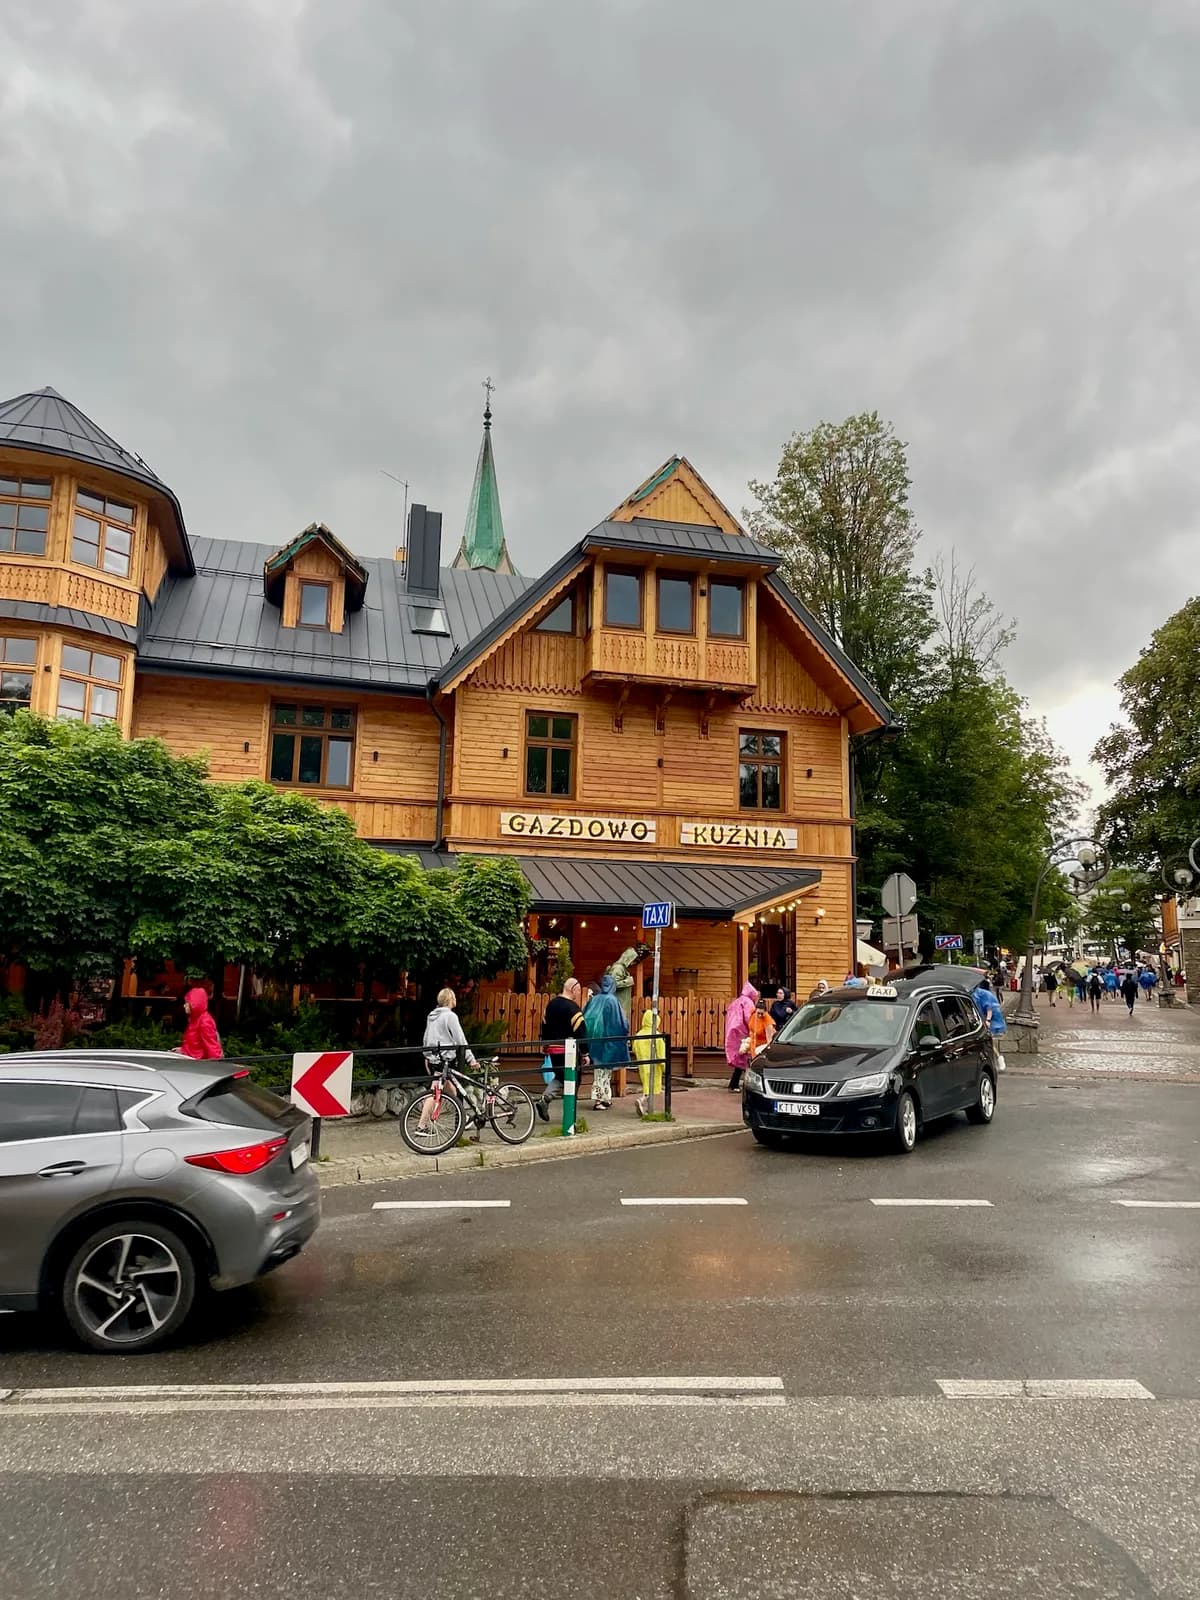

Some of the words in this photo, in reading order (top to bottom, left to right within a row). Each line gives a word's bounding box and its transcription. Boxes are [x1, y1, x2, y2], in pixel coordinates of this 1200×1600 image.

[509, 814, 648, 840] GAZDOWO
[645, 905, 668, 925] TAXI
[936, 937, 961, 947] TAXI
[871, 987, 893, 995] TAXI
